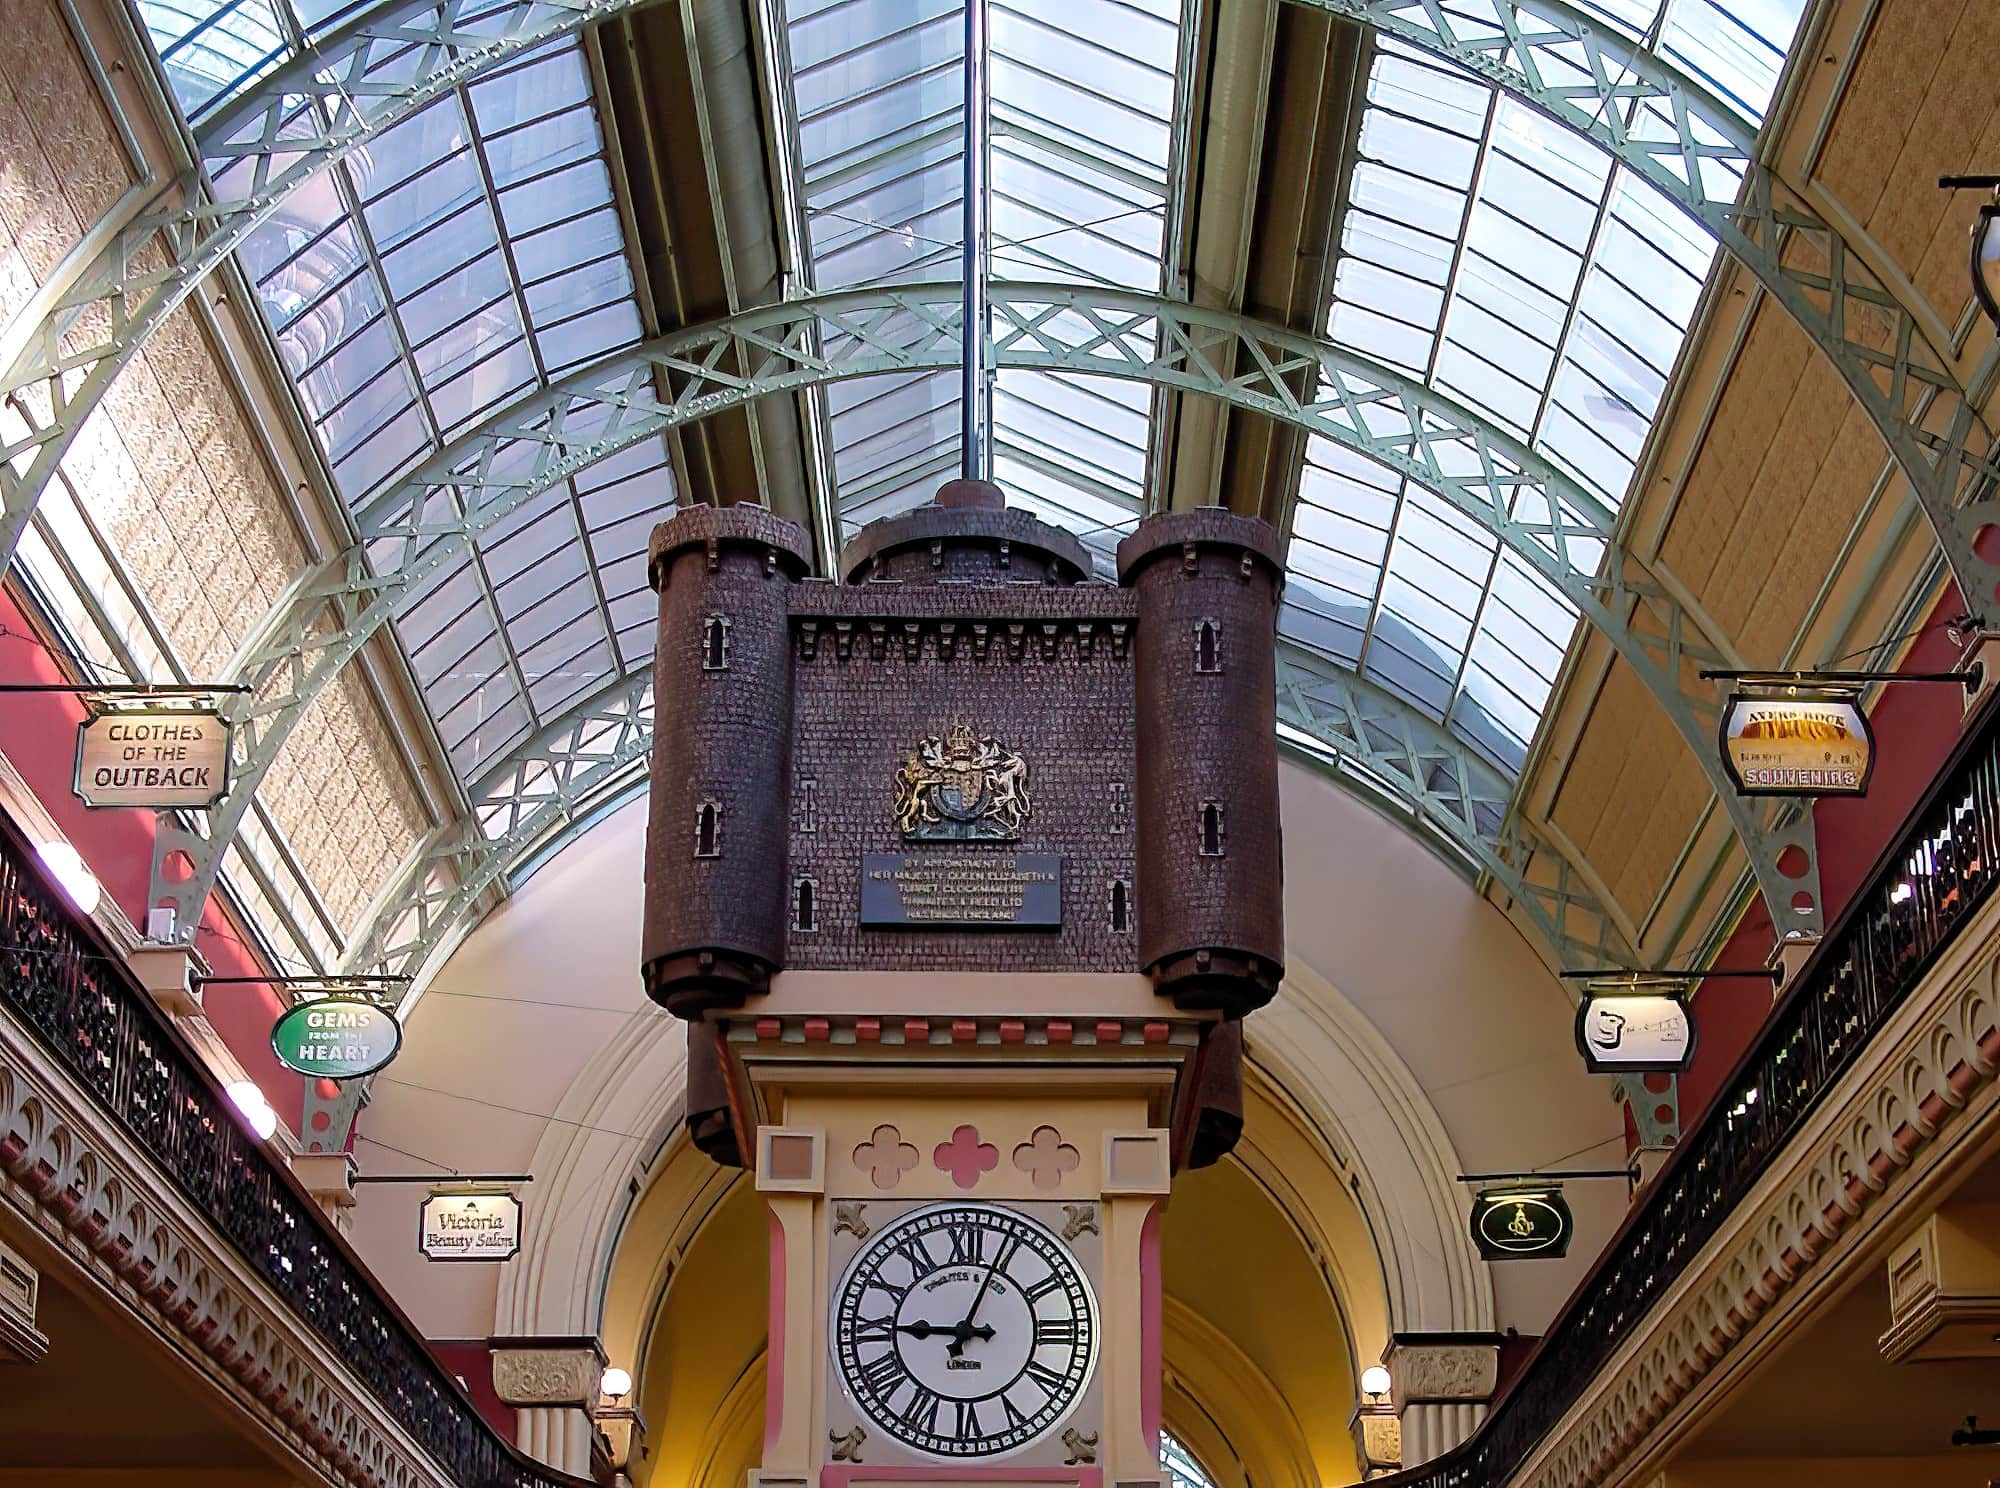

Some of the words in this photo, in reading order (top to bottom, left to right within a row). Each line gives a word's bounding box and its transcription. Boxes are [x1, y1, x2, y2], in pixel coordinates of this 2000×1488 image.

[1804, 711, 1846, 727] ROCK
[108, 725, 204, 741] CLOTHES
[123, 747, 147, 761] OF
[154, 747, 187, 761] THE
[95, 767, 210, 787] OUTBACK
[1745, 768, 1857, 786] SOUVENIRS
[307, 1012, 370, 1028] GEMS
[299, 1045, 371, 1060] HEART
[439, 1213, 505, 1230] Victoria
[427, 1233, 473, 1253] Beauty
[476, 1232, 515, 1247] Salon
[1038, 1319, 1074, 1346] III
